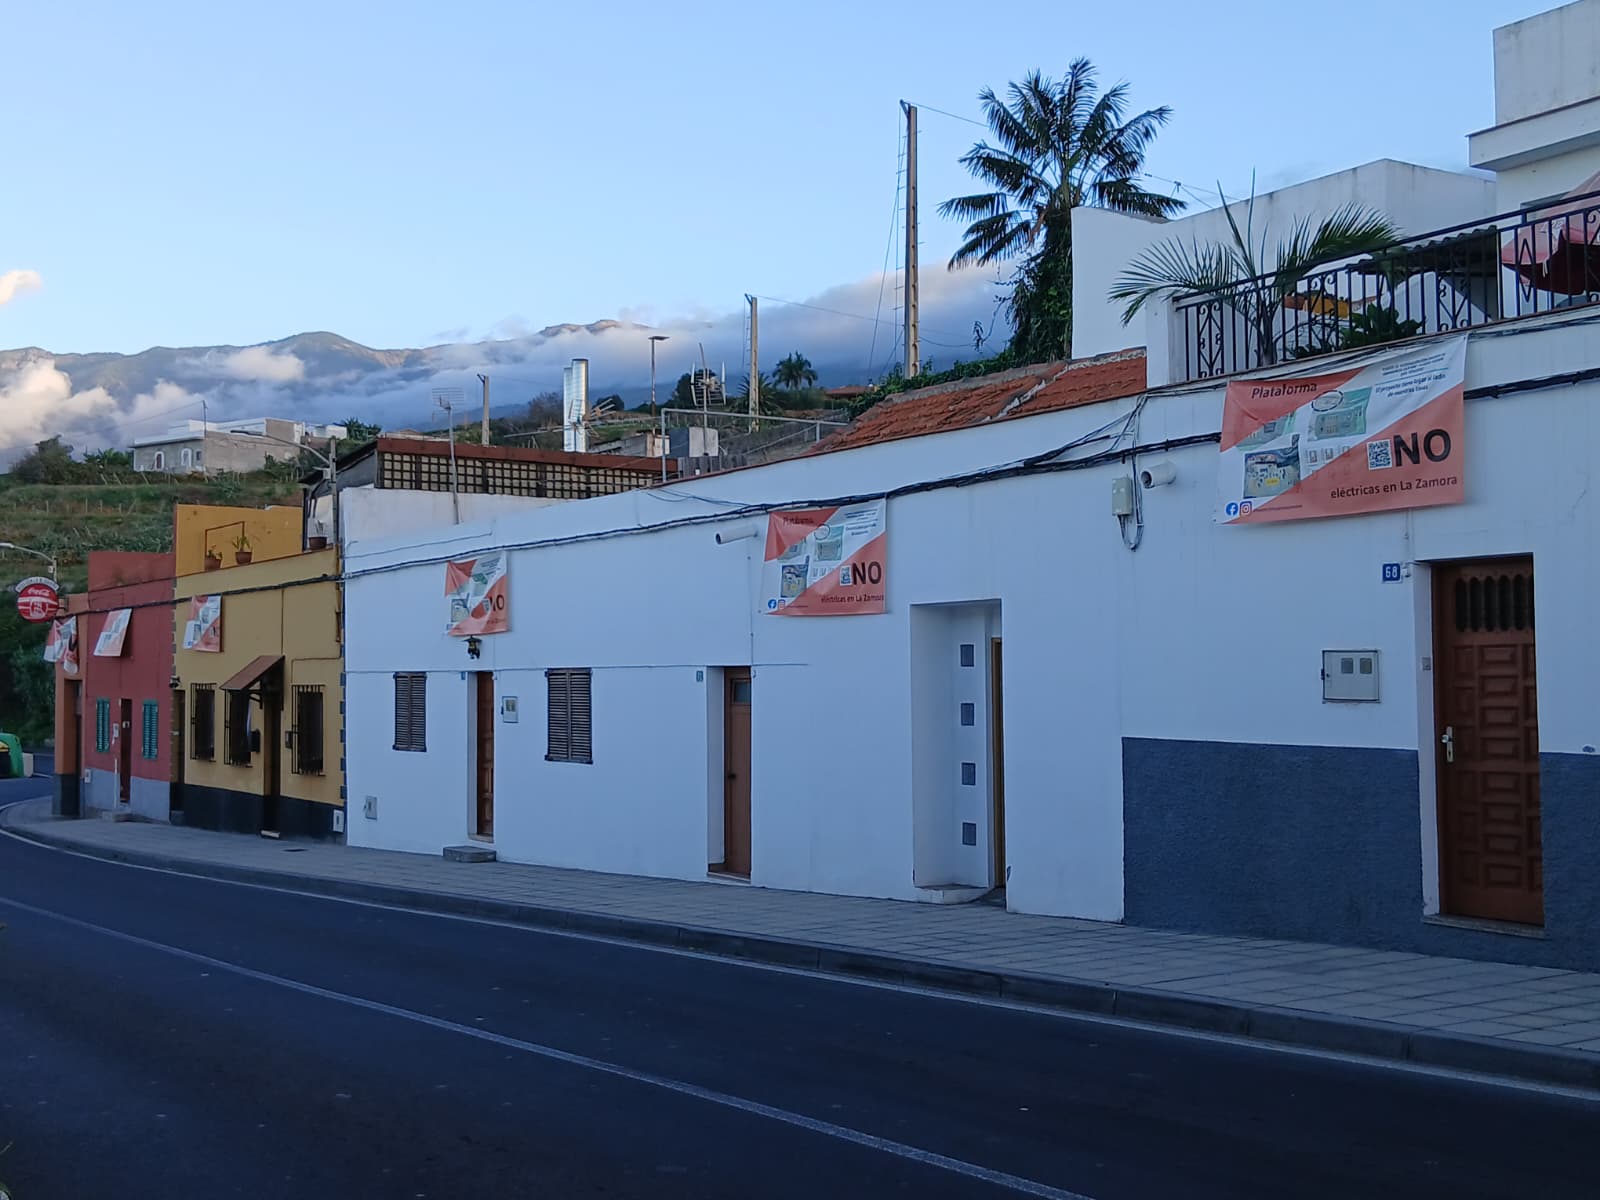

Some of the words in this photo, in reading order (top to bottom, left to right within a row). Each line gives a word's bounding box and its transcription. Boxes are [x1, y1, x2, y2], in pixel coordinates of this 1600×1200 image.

[1251, 382, 1317, 399] Plataforma
[1393, 428, 1451, 467] NO
[1330, 485, 1380, 499] eléctricas
[1383, 483, 1397, 493] en
[1400, 480, 1412, 490] La
[1415, 476, 1457, 489] Zamora
[852, 562, 882, 585] NO
[1385, 565, 1398, 577] 68
